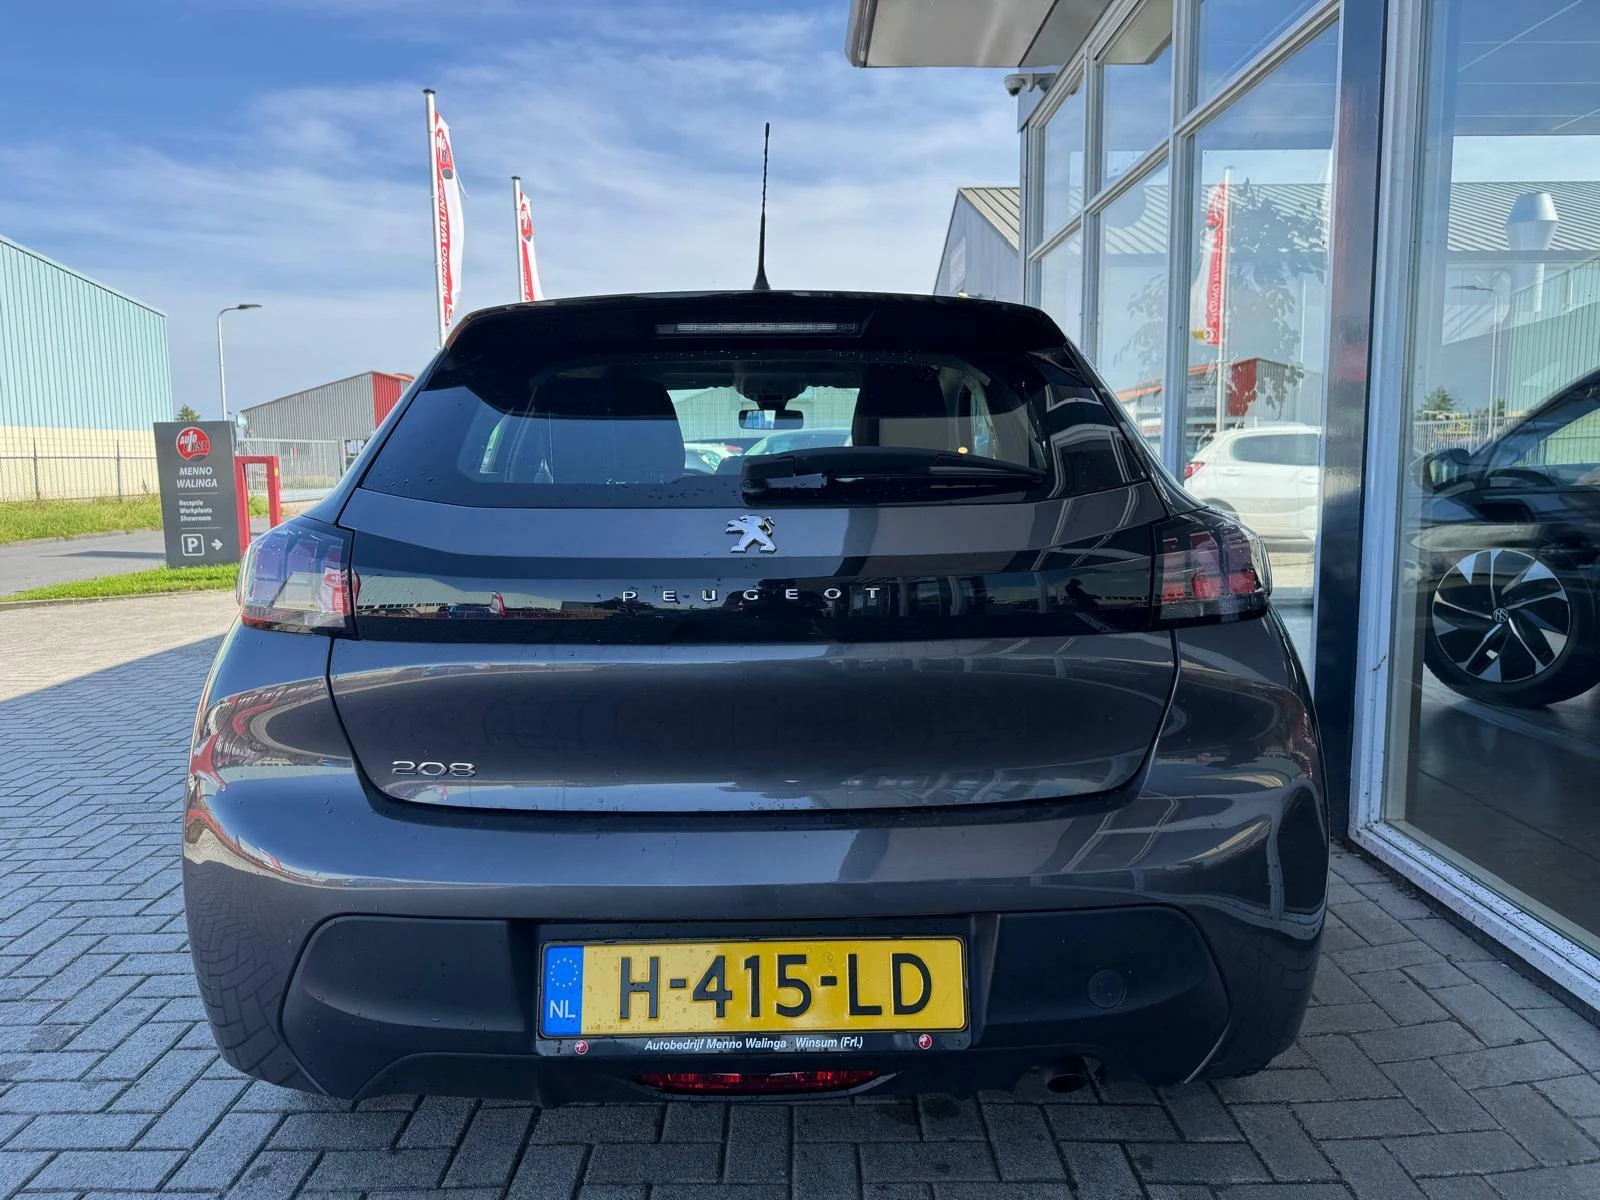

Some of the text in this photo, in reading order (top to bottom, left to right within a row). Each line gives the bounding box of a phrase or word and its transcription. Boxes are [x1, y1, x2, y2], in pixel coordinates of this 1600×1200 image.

[179, 466, 213, 476] MENNO
[176, 478, 218, 488] WALINGA
[178, 499, 204, 507] Receptie
[179, 507, 213, 515] Werkplaats
[187, 537, 199, 553] P
[622, 587, 880, 602] PEUGEOT
[391, 760, 476, 777] 208
[618, 952, 933, 1020] H-415-LD
[548, 999, 577, 1019] NL
[644, 1036, 864, 1052] Autobedrijf Menno Walinga Winsum (Frl.)
